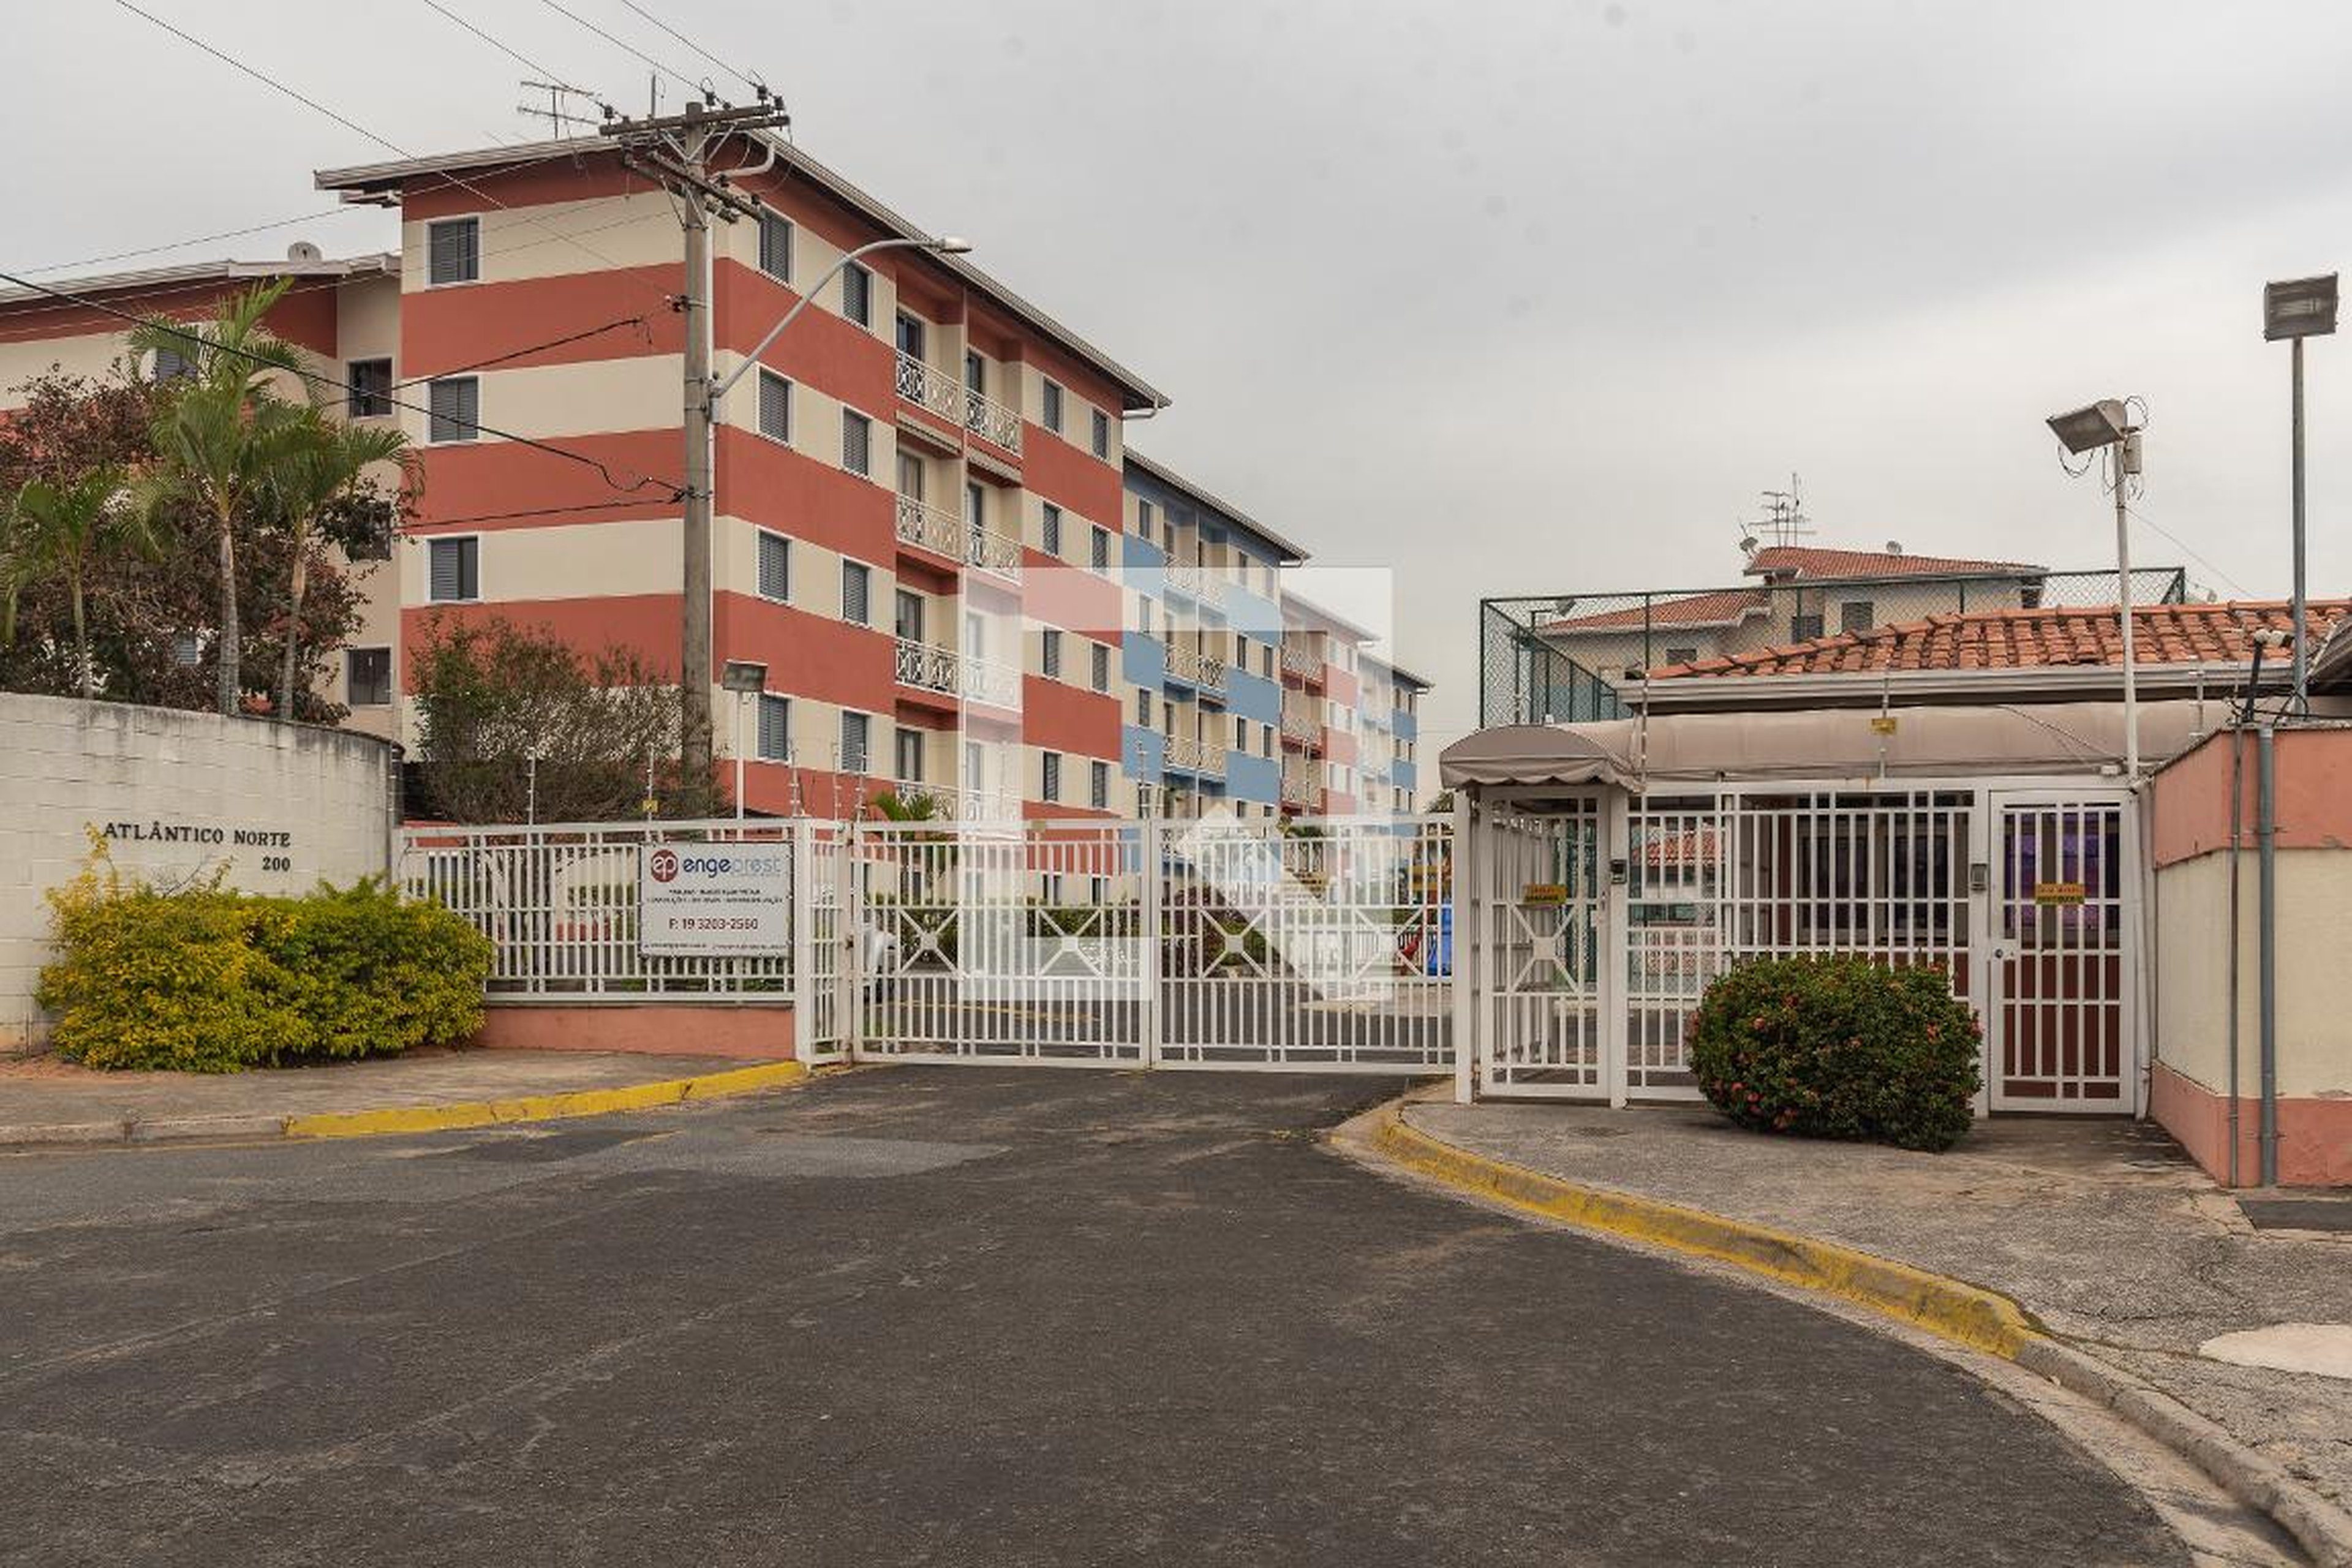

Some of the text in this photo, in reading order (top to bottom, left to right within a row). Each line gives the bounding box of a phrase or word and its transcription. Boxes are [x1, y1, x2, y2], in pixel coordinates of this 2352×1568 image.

[102, 821, 291, 847] ATLÂNTICO NORTE
[262, 856, 291, 872] 200
[683, 918, 695, 930] 19
